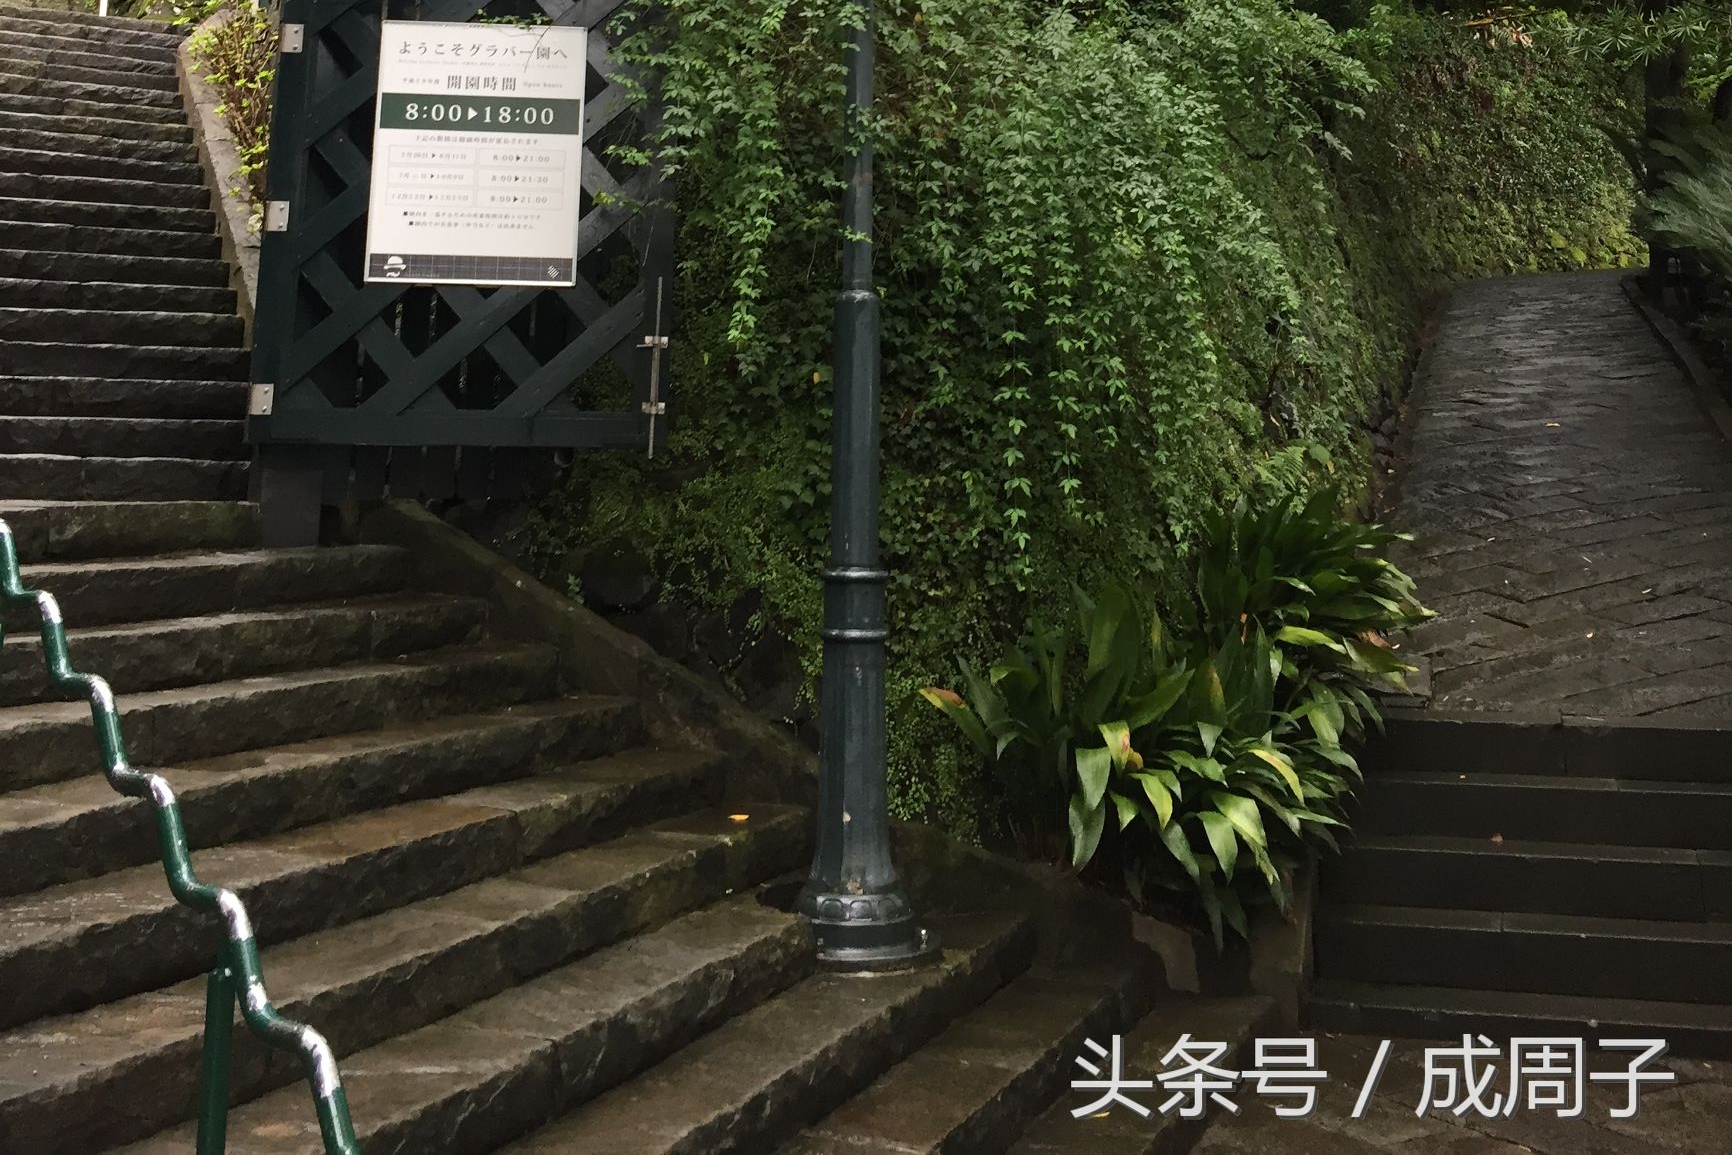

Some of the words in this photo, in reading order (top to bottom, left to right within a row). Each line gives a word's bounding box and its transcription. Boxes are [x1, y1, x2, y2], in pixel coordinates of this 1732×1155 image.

[398, 40, 568, 60] ようこそグラバー園へ
[447, 75, 517, 92] 開園時間
[405, 103, 462, 122] 8:00
[483, 105, 555, 125] 18:00
